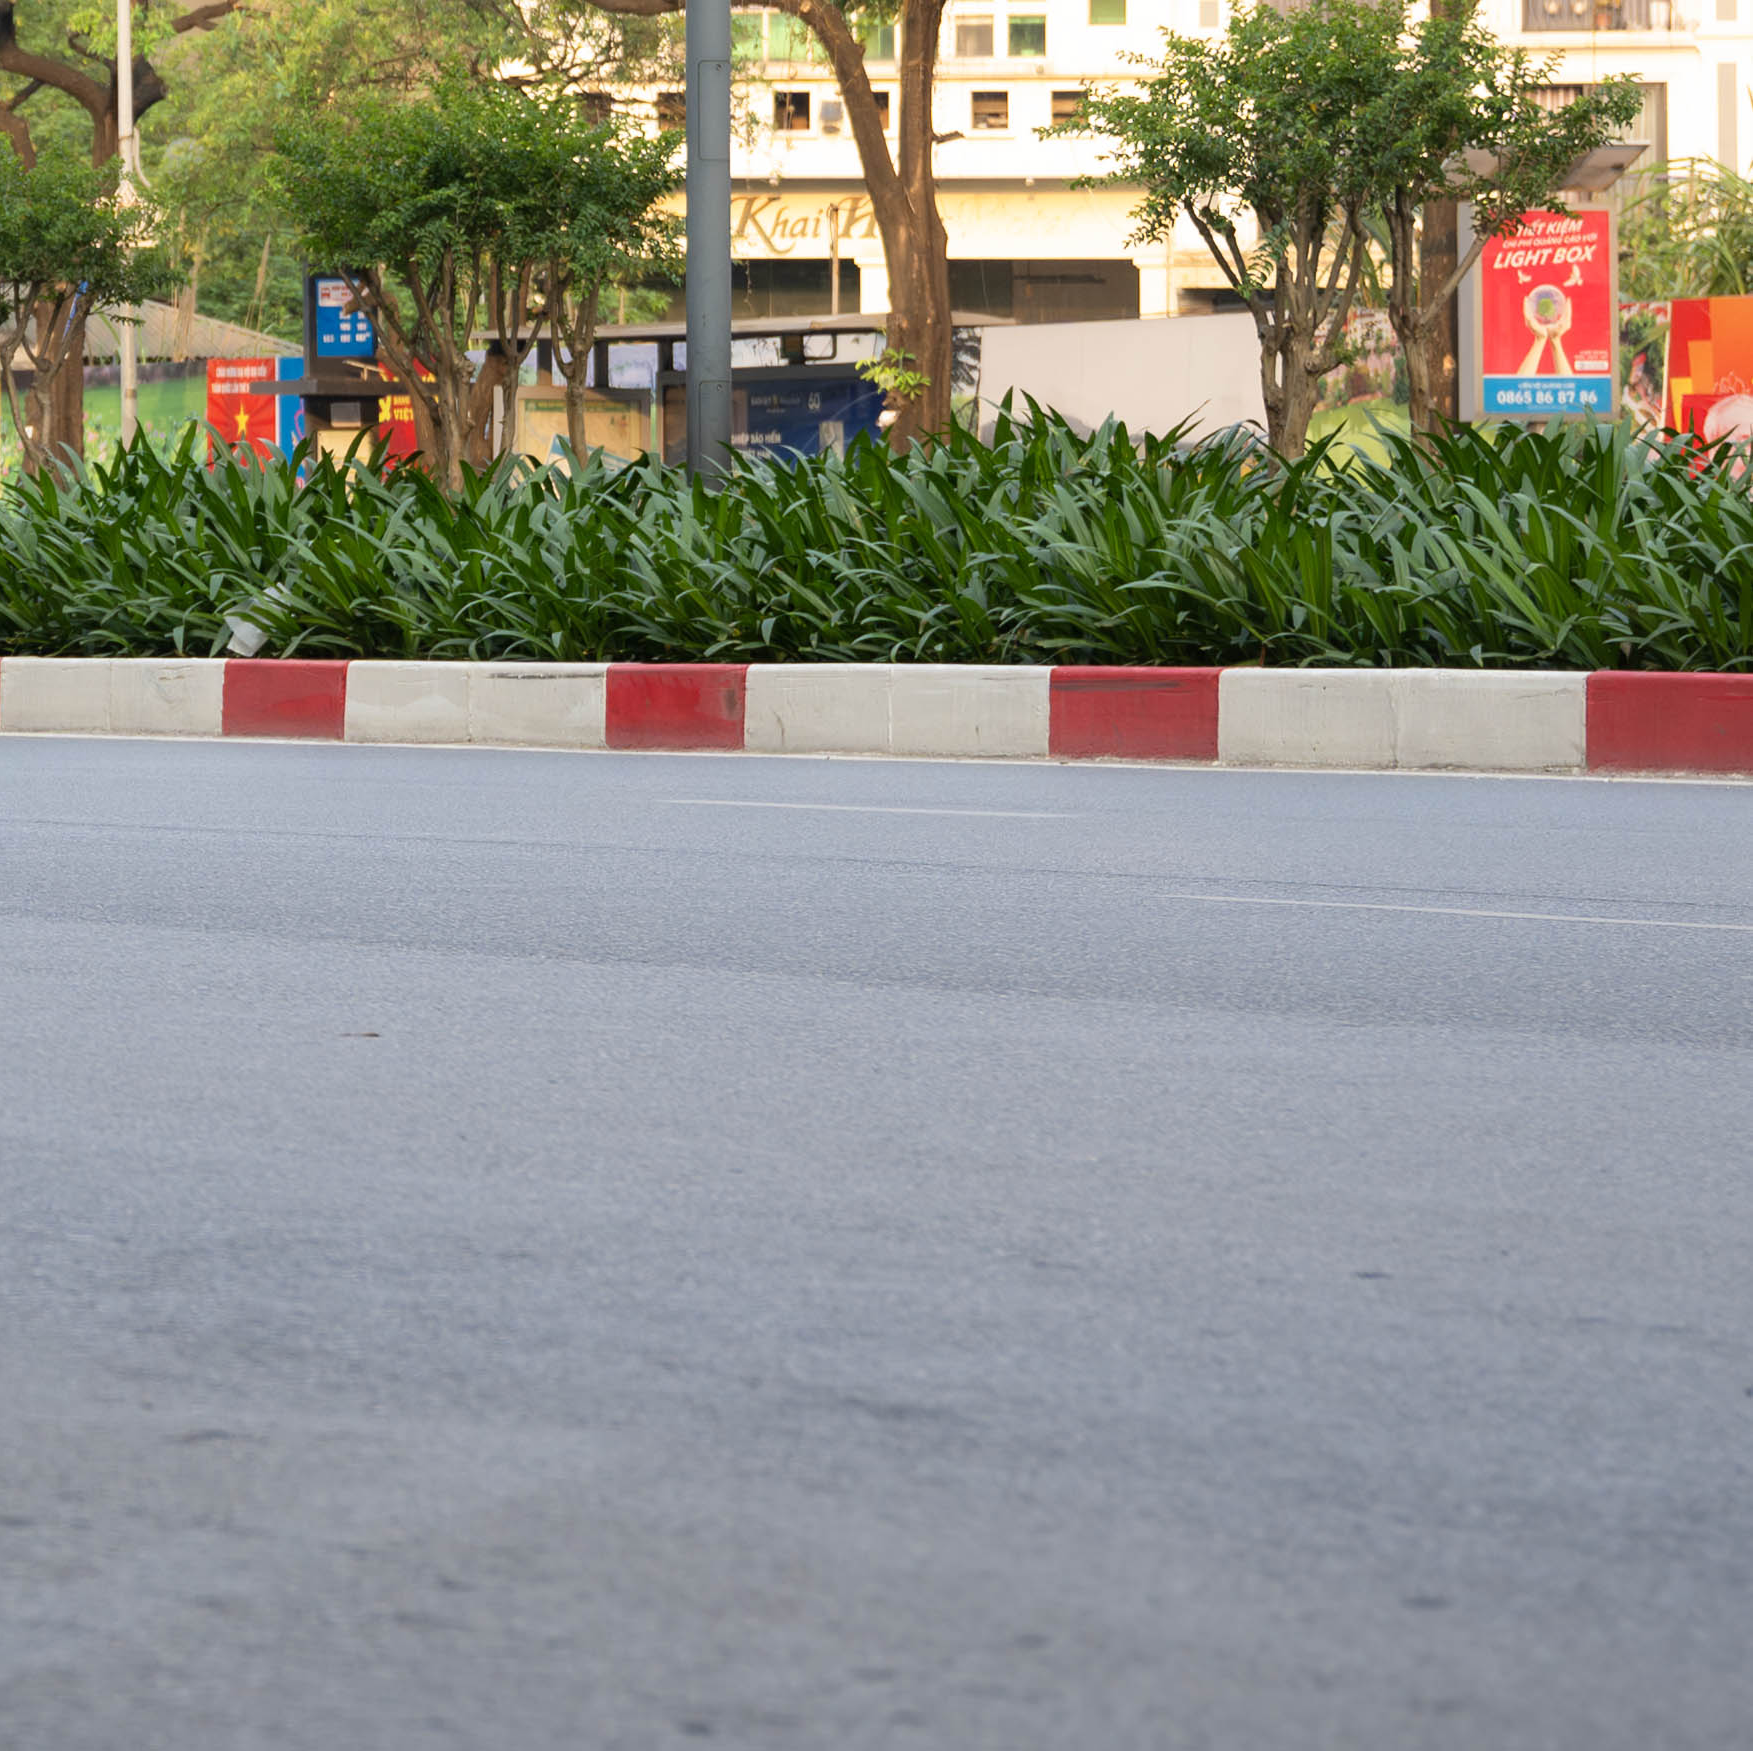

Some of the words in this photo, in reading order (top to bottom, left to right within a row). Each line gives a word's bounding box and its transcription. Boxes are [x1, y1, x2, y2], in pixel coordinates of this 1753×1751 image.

[731, 195, 824, 254] Khai
[1546, 217, 1583, 237] KIỆM
[1493, 248, 1552, 269] LIGHT
[1552, 244, 1597, 264] BOX
